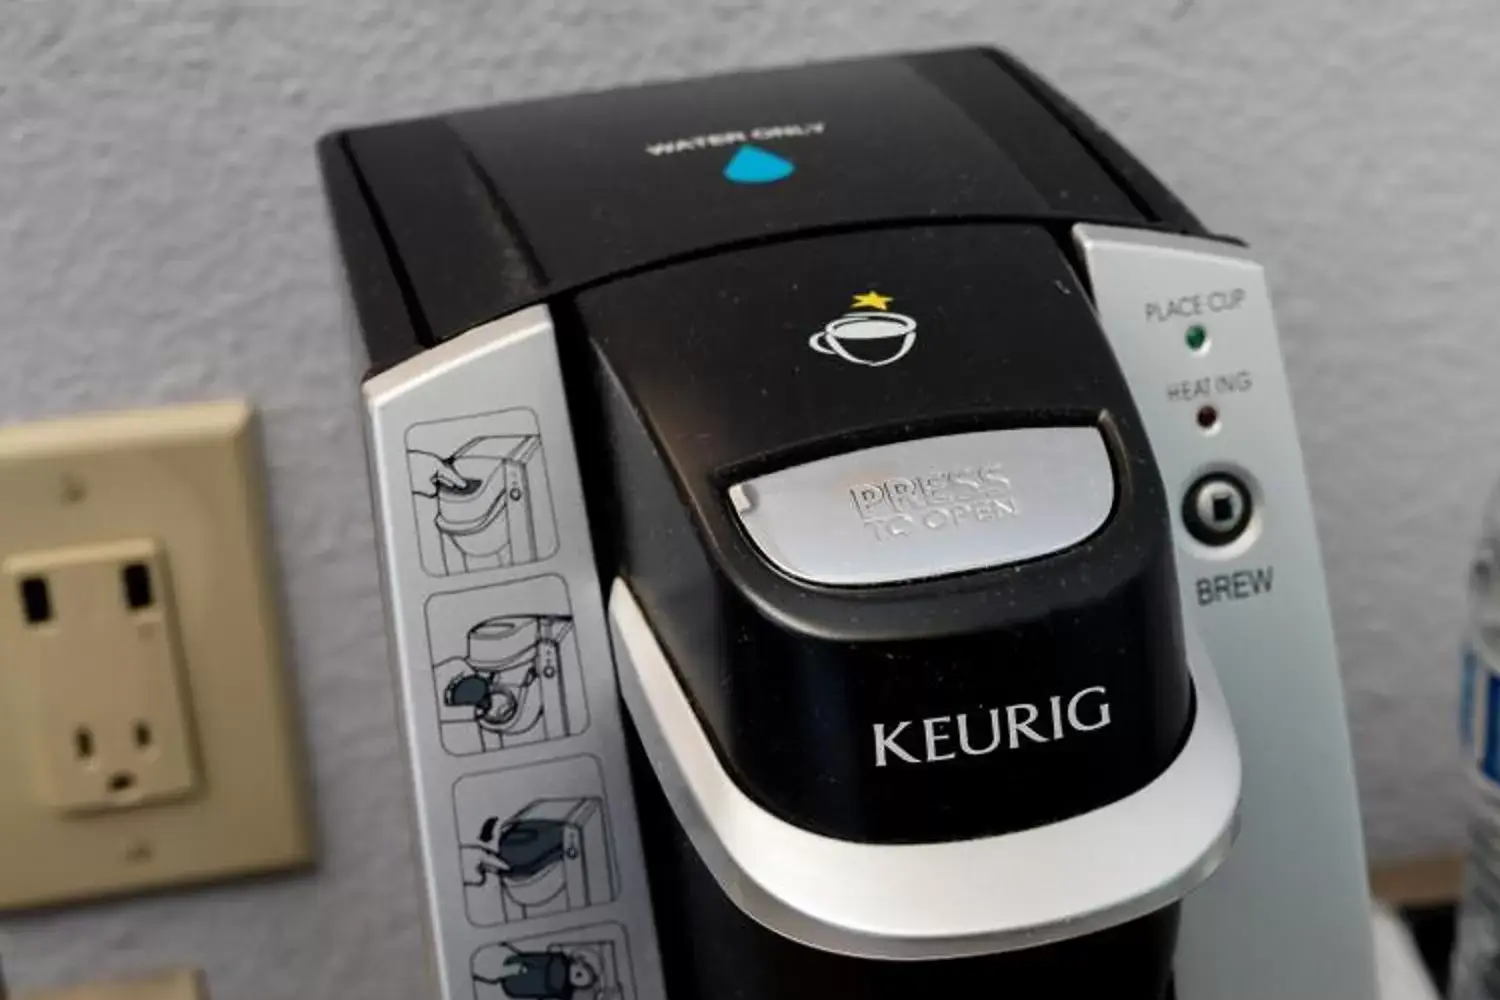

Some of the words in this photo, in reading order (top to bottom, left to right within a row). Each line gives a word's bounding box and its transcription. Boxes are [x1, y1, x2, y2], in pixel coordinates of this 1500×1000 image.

[644, 130, 746, 156] WATER
[749, 121, 826, 141] ONLY
[1144, 295, 1203, 324] PLACE
[1207, 287, 1247, 314] CUP
[1166, 370, 1254, 401] HEATING
[850, 462, 1011, 520] PRESS
[863, 513, 914, 543] TO
[924, 497, 1019, 531] OPEN
[1195, 565, 1274, 608] BREW
[872, 685, 1111, 768] KEURIG
